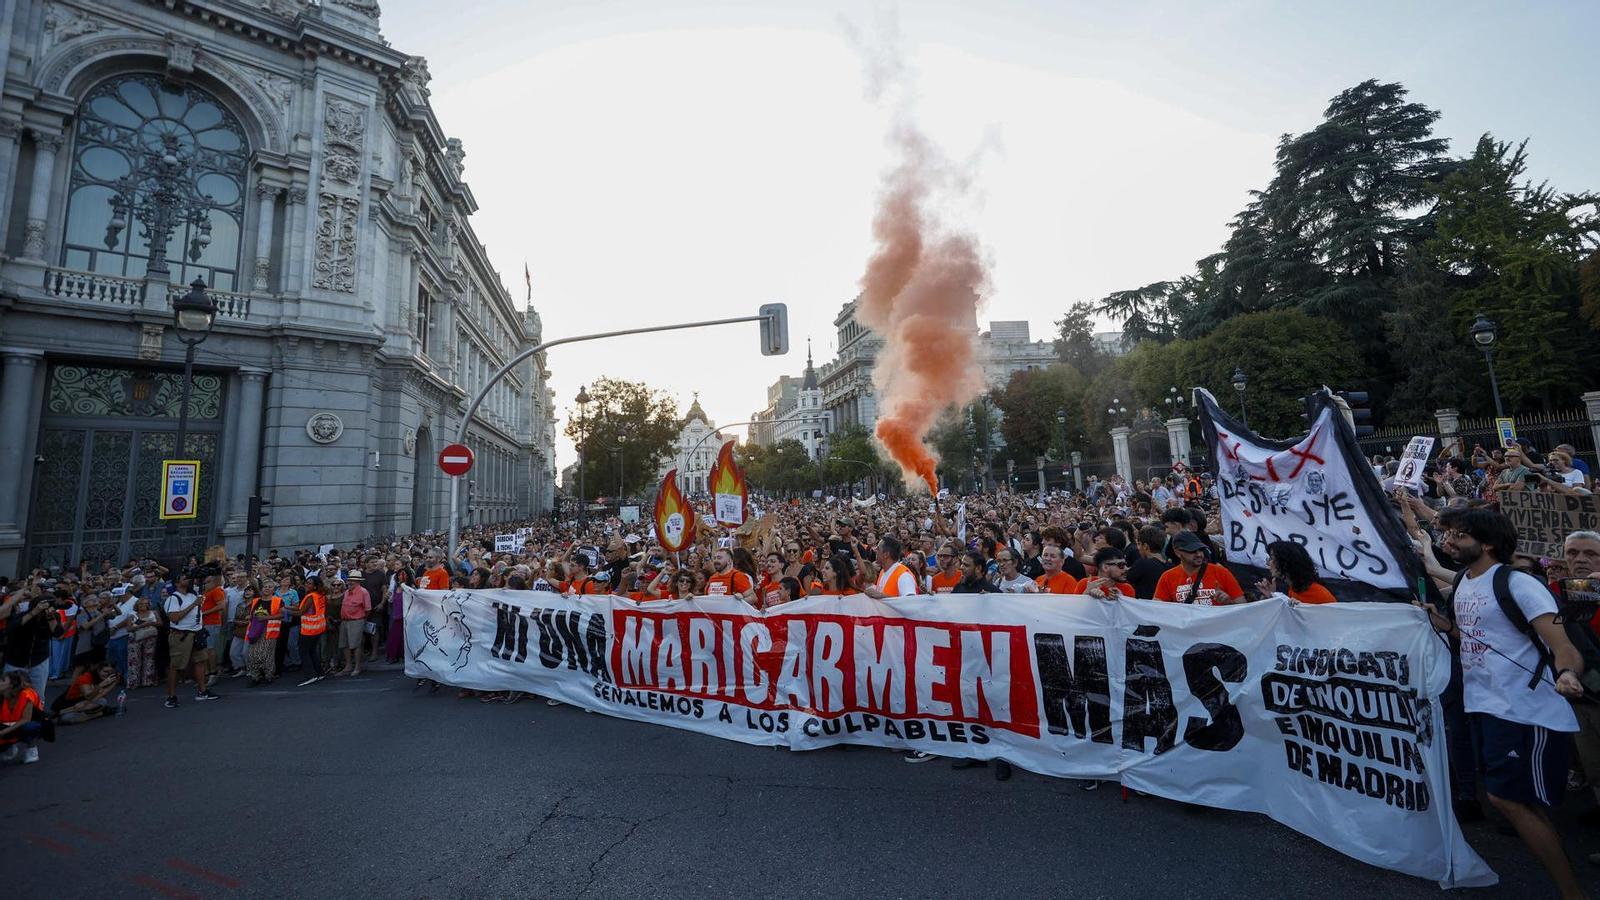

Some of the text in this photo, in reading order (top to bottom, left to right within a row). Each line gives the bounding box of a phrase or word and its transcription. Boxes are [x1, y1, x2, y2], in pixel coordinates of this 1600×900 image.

[1502, 491, 1597, 512] EL PLAN DE
[1502, 507, 1598, 529] VIVIENDA NO
[1518, 527, 1547, 541] EBE
[490, 601, 1248, 755] NI UNA MARICARMEN MÁS
[1270, 681, 1304, 709] DE
[718, 703, 732, 724] A
[747, 709, 789, 733] LOS
[802, 713, 990, 745] CULPABLES
[1275, 714, 1425, 775] E INQUILIN
[1284, 739, 1430, 811] DE MADRID
